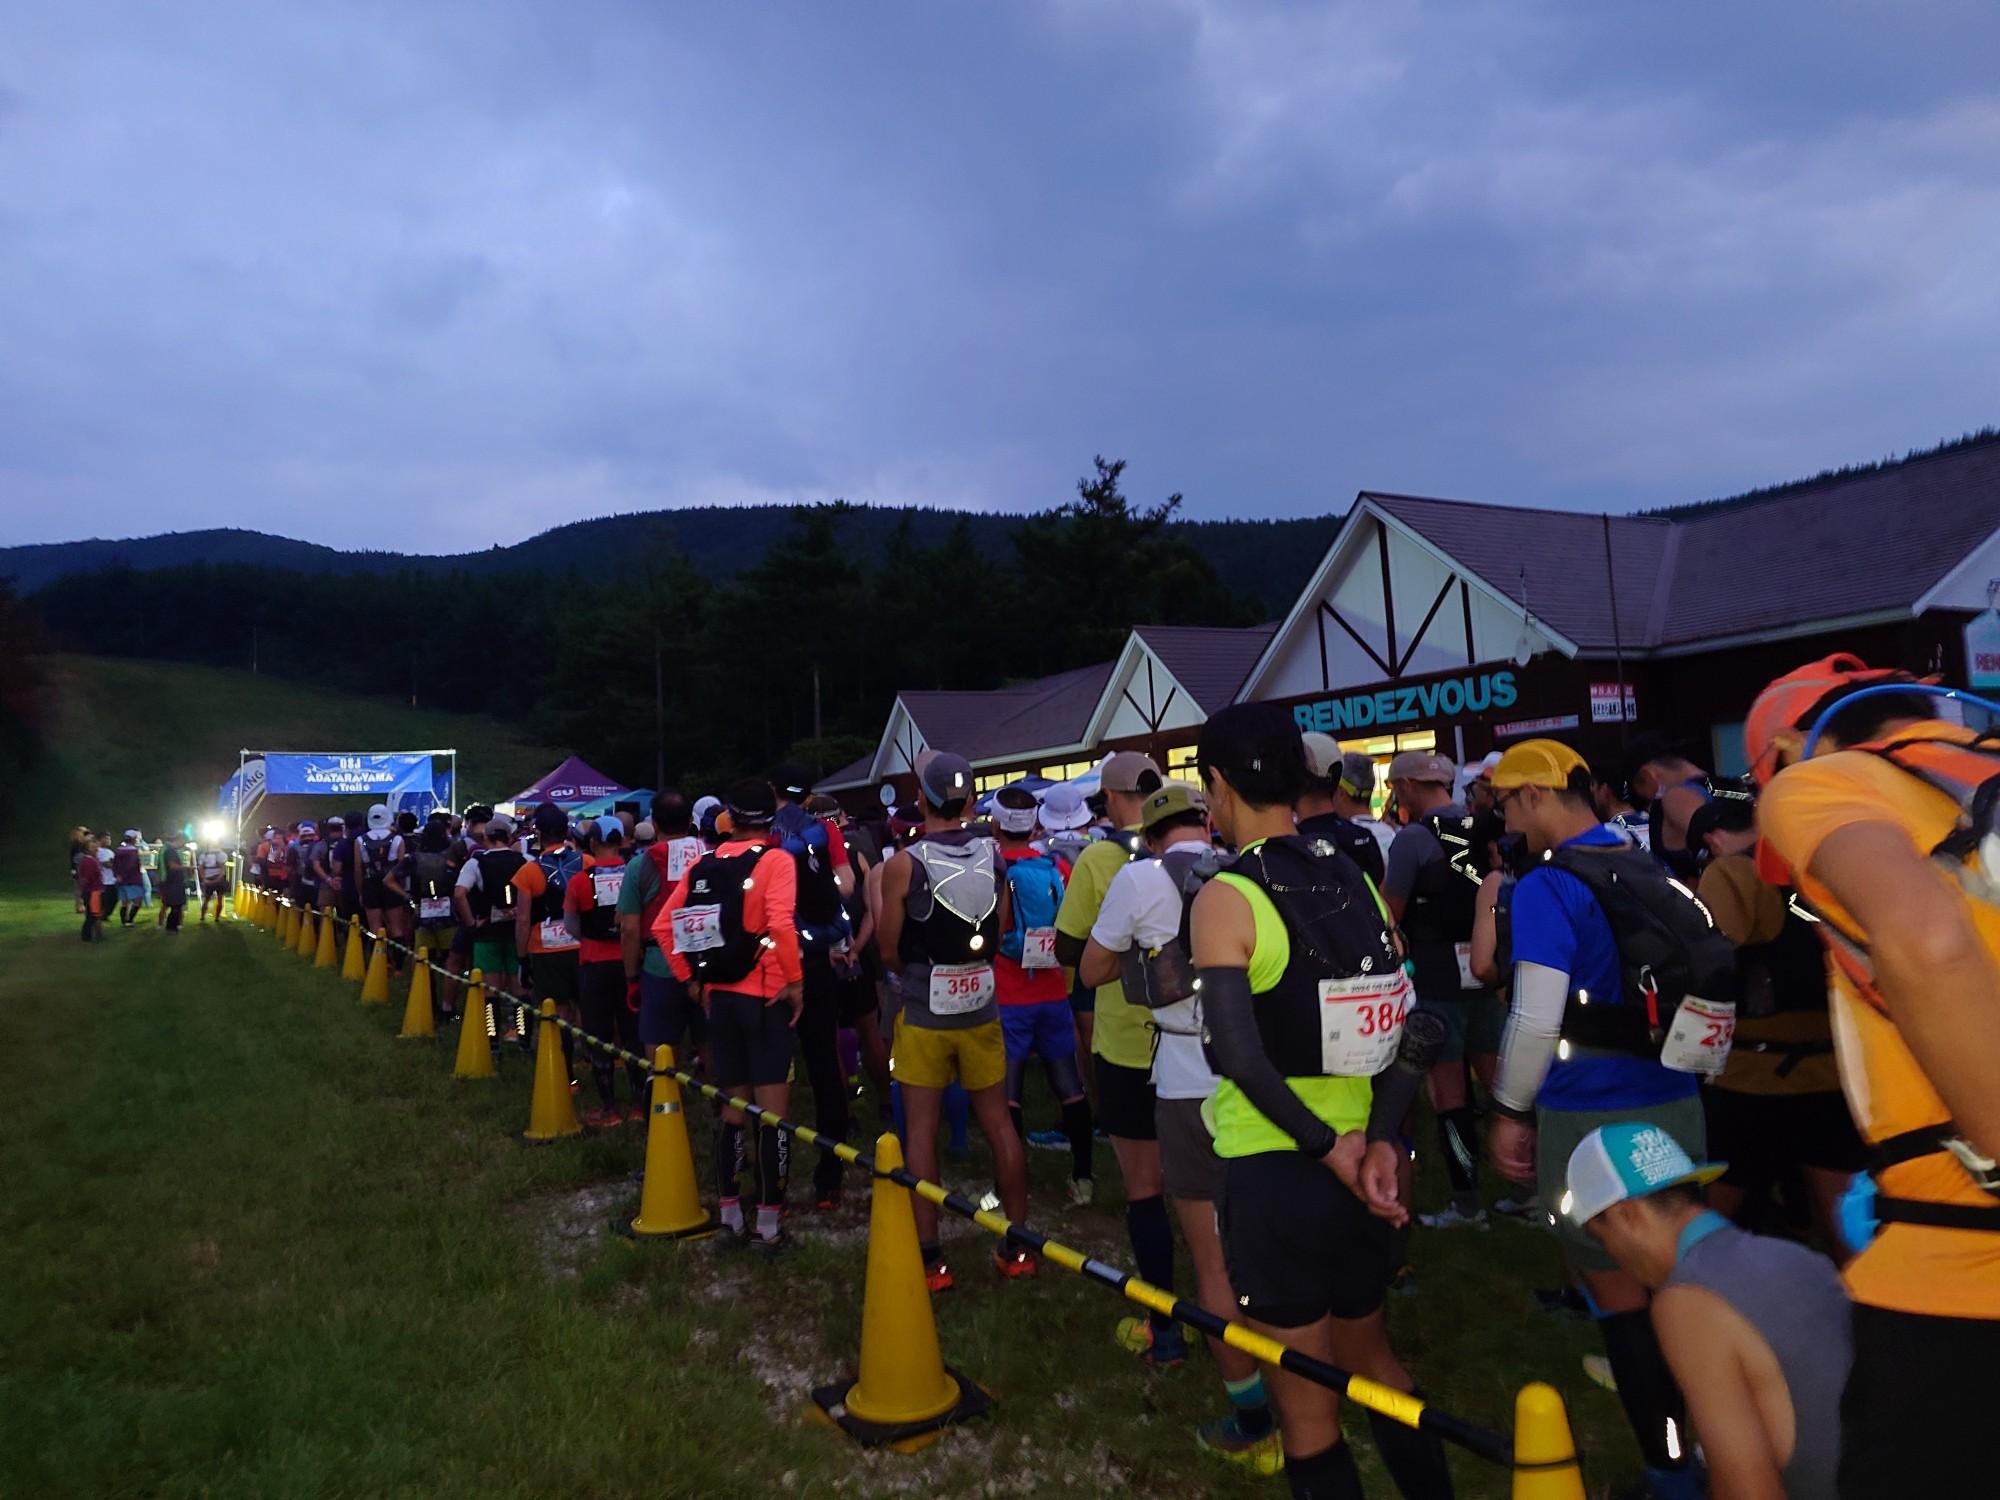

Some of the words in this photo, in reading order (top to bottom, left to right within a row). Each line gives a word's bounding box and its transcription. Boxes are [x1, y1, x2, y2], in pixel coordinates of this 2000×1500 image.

[1293, 671, 1518, 733] RENDEZVOUS
[550, 788, 574, 797] GU
[1039, 938, 1057, 953] 12
[947, 976, 980, 995] 356
[1356, 999, 1406, 1037] 384
